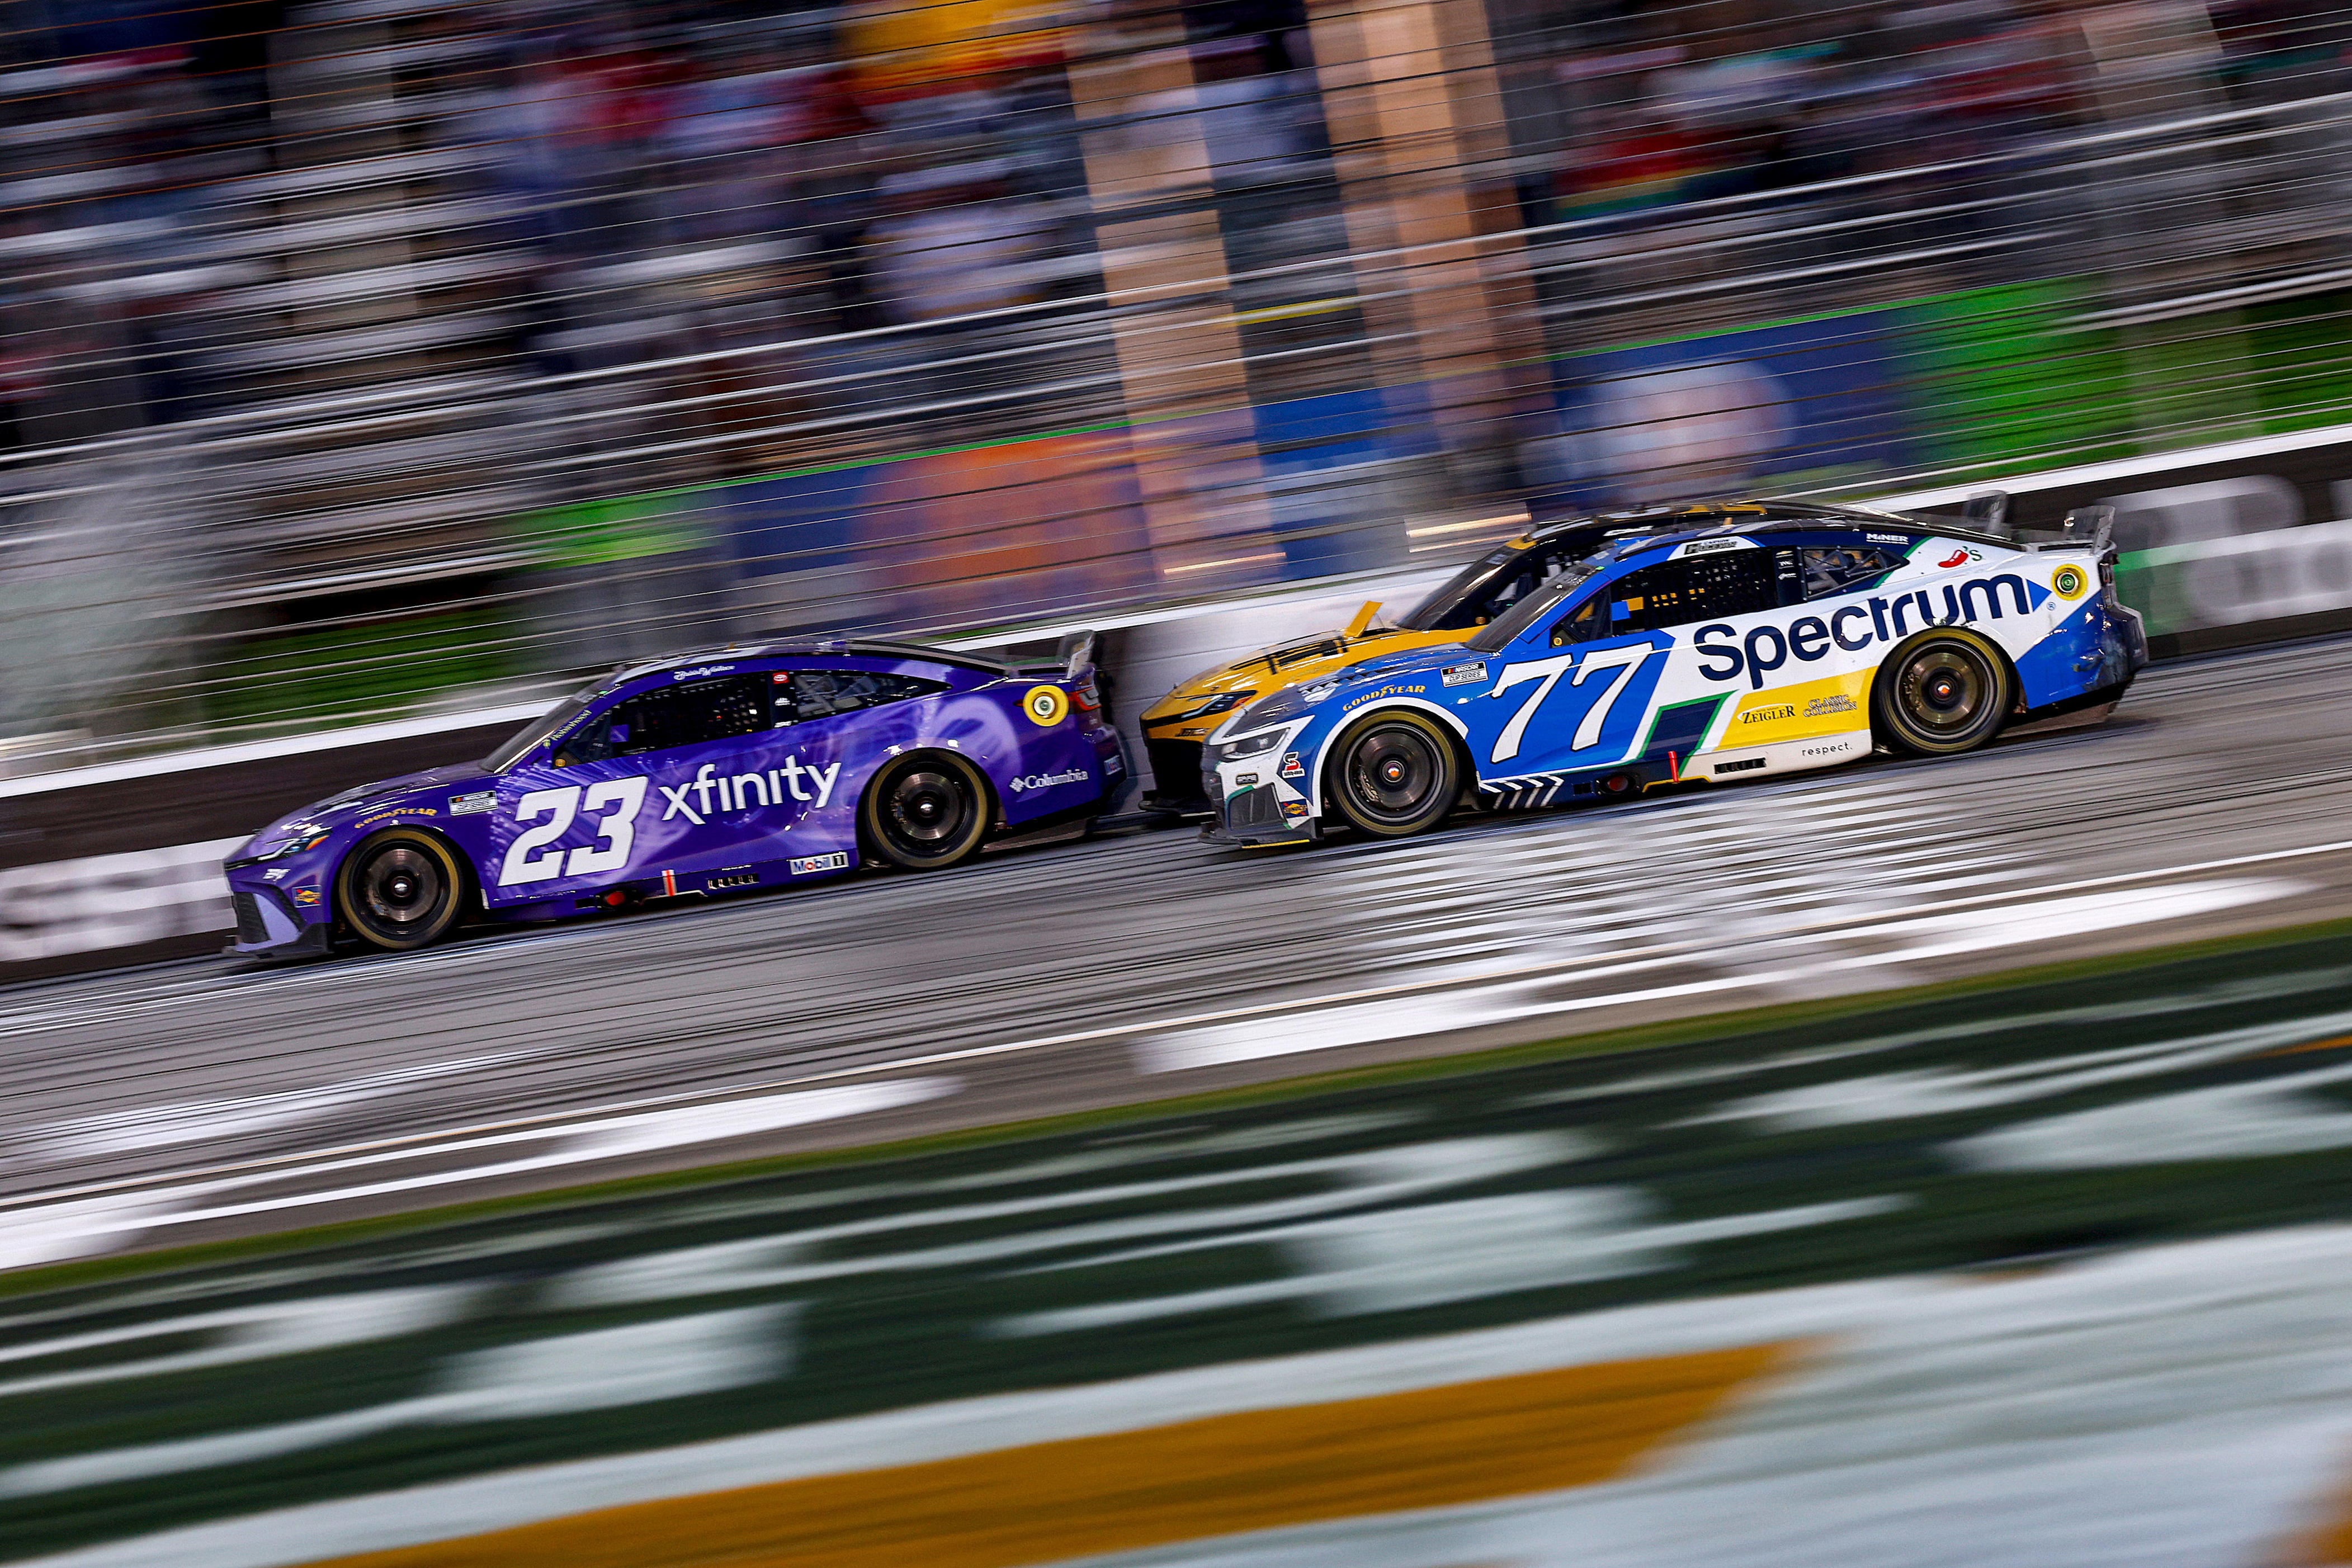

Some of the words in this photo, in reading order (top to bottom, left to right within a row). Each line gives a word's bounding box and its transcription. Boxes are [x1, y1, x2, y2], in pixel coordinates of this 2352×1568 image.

[1693, 574, 2030, 690] Spectrum
[1343, 685, 1426, 711] GOODYEAR
[1490, 642, 1653, 764] 77
[1808, 694, 1850, 708] CLASSIC
[1742, 705, 1796, 724] ZEIGLER
[1802, 701, 1857, 717] COLLISION
[1802, 742, 1853, 756] respect.
[1024, 768, 1089, 788] Columbia
[659, 755, 842, 824] xfinity
[497, 776, 649, 887] 23
[794, 857, 830, 872] Mobil
